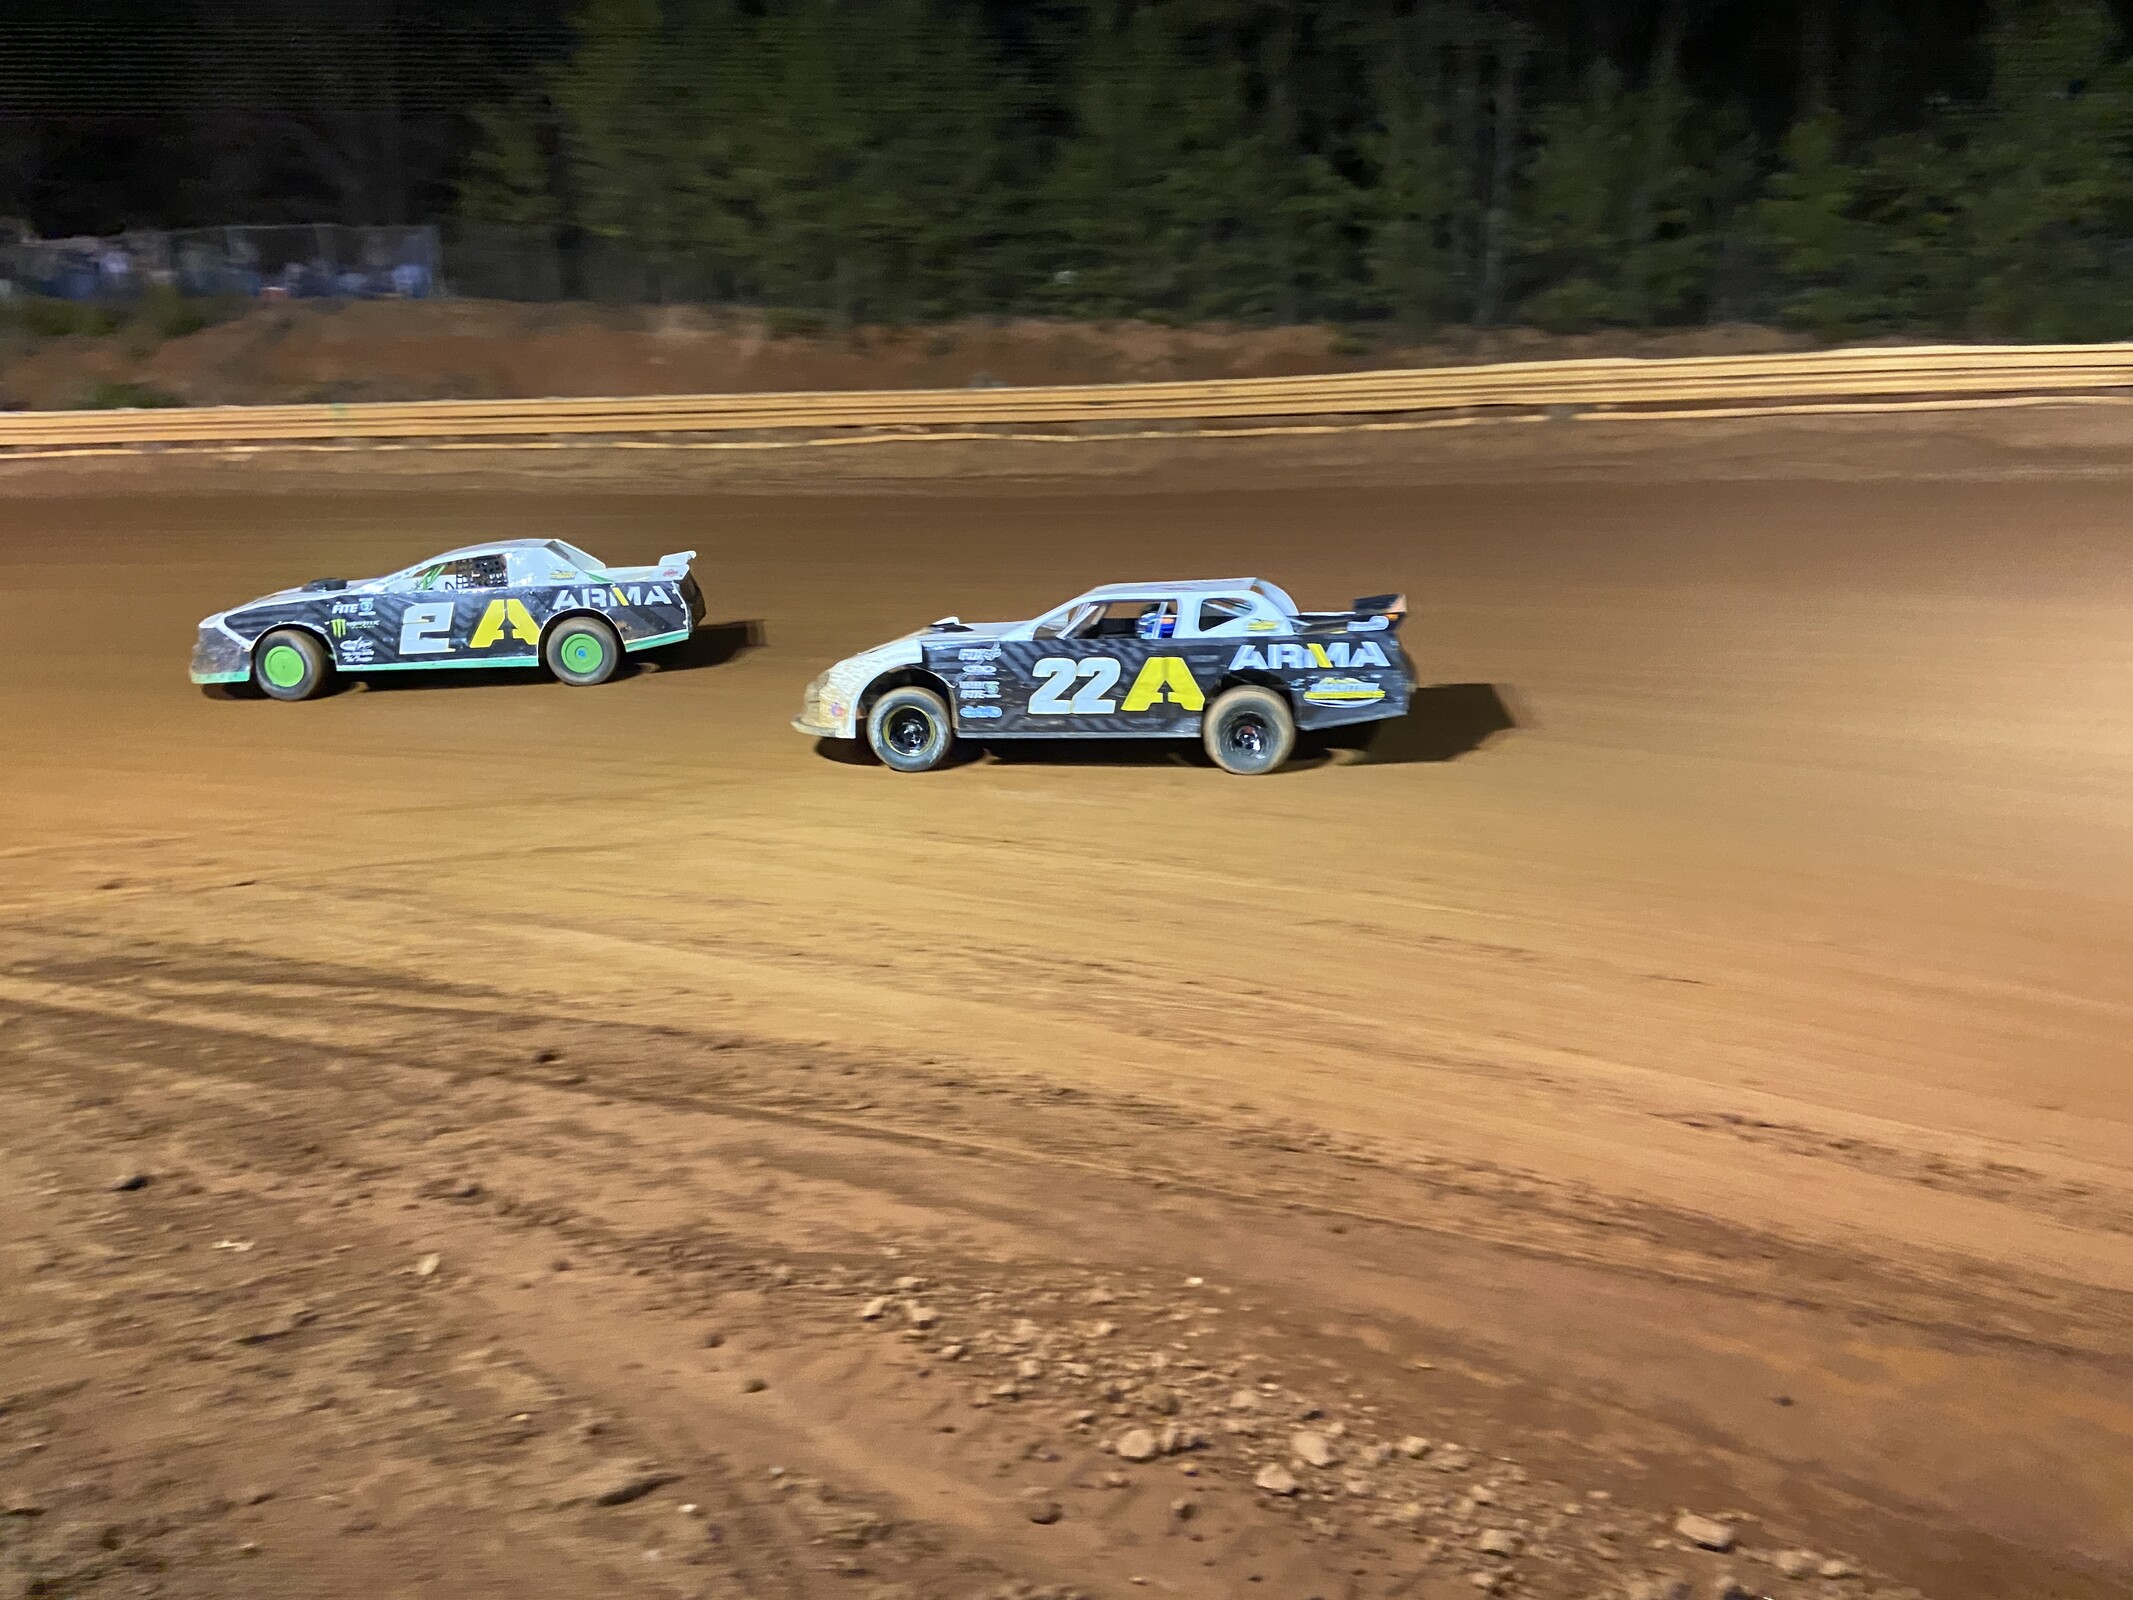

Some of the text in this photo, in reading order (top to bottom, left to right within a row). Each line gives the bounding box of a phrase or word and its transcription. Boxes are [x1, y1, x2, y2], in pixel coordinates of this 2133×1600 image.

[469, 598, 541, 649] A
[552, 585, 673, 611] ARMA
[399, 601, 456, 655] 2
[1228, 641, 1391, 670] ARMA
[1028, 656, 1122, 715] 22
[1120, 656, 1206, 712] A
